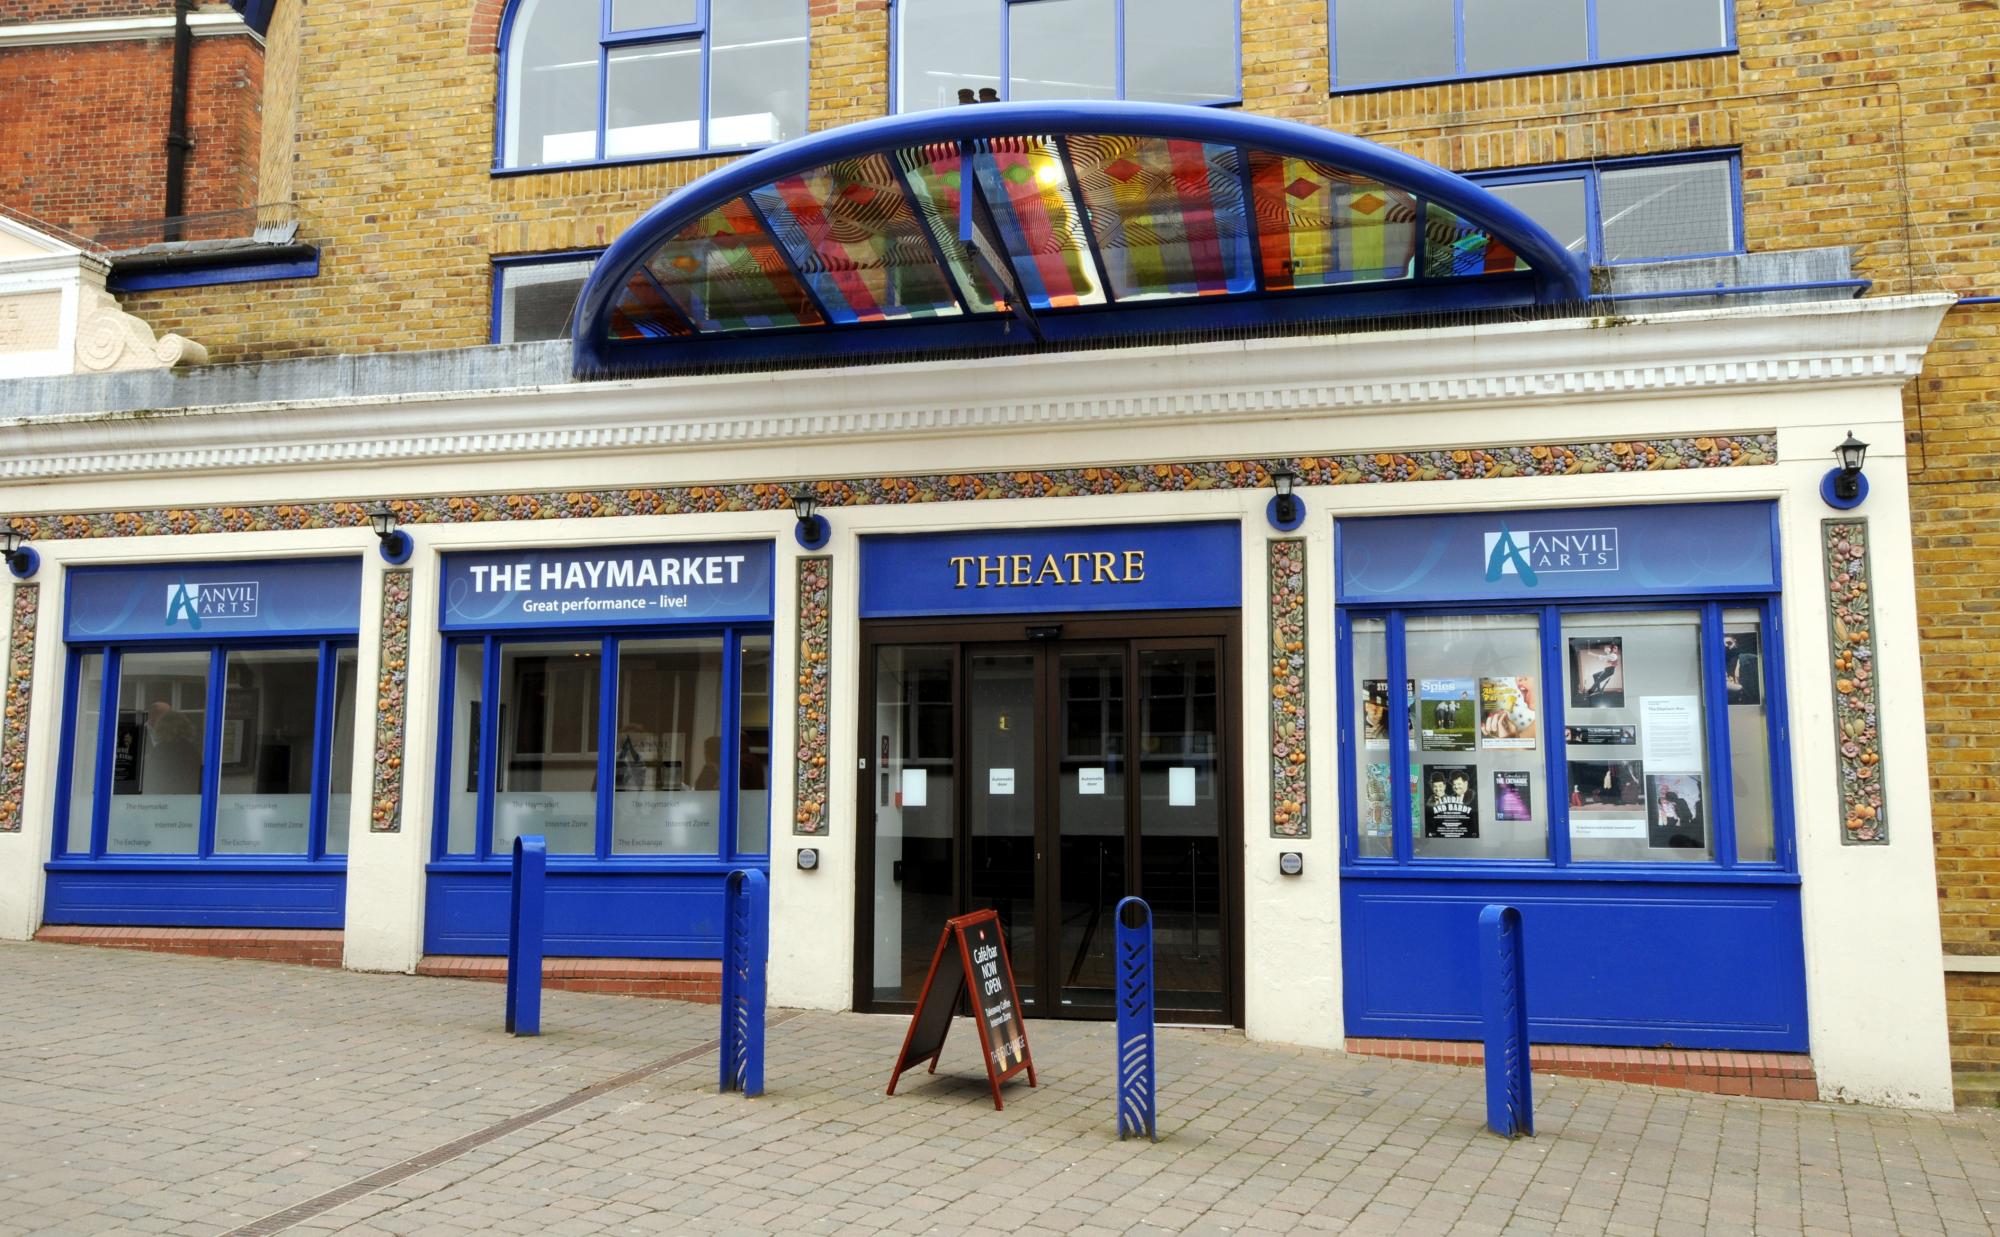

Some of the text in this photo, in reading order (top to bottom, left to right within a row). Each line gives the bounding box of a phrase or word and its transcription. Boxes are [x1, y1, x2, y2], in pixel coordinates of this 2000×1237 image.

[1532, 534, 1614, 553] ANVIL
[1539, 552, 1607, 567] ARTS
[469, 555, 745, 593] THE HAYMARKET
[949, 550, 1145, 588] THEATRE
[199, 587, 255, 602] ANVIL
[203, 601, 250, 614] ARTS
[522, 599, 559, 613] Great
[561, 596, 646, 614] performance
[659, 594, 688, 608] live!
[1422, 681, 1456, 692] Spies
[1433, 803, 1472, 814] AND HARDY
[124, 838, 152, 847] Exchange
[981, 960, 997, 979] NOW
[984, 976, 1002, 996] OPEN
